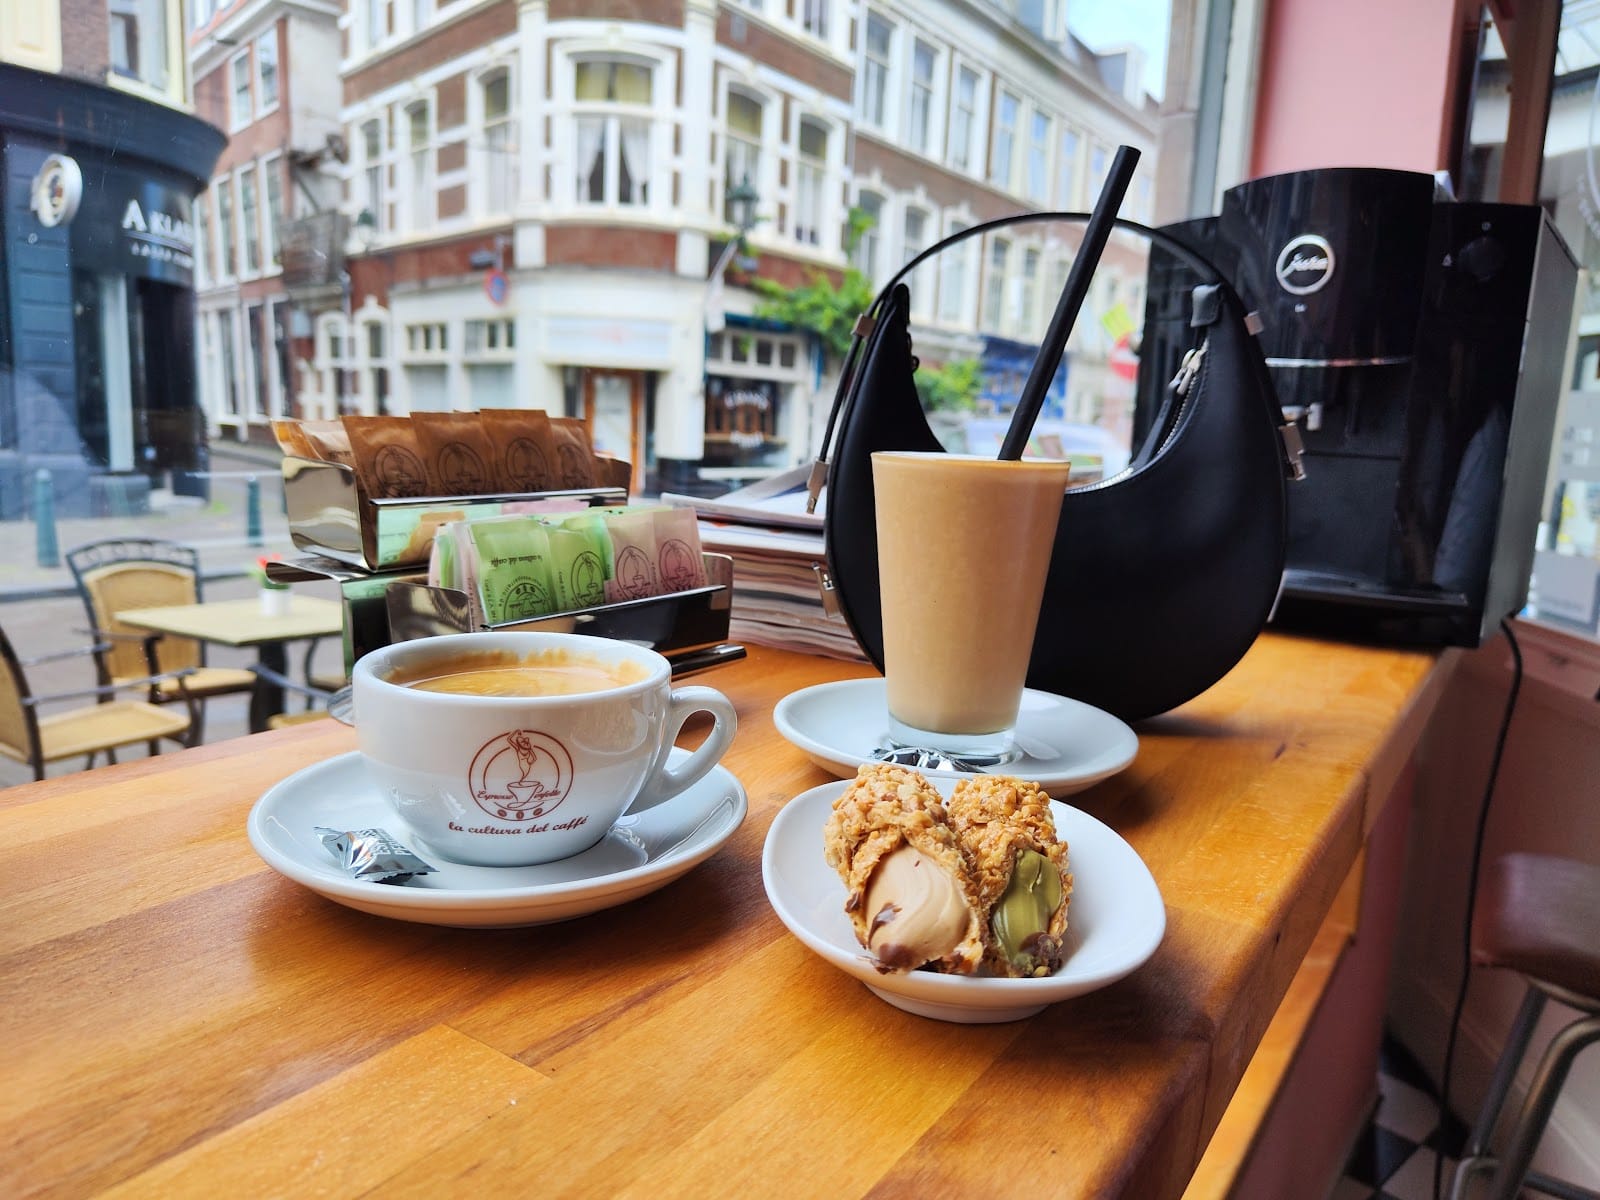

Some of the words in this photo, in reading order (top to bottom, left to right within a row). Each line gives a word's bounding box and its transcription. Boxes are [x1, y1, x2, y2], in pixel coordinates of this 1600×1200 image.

[449, 821, 464, 832] la
[468, 823, 522, 835] cultura
[526, 822, 549, 833] del
